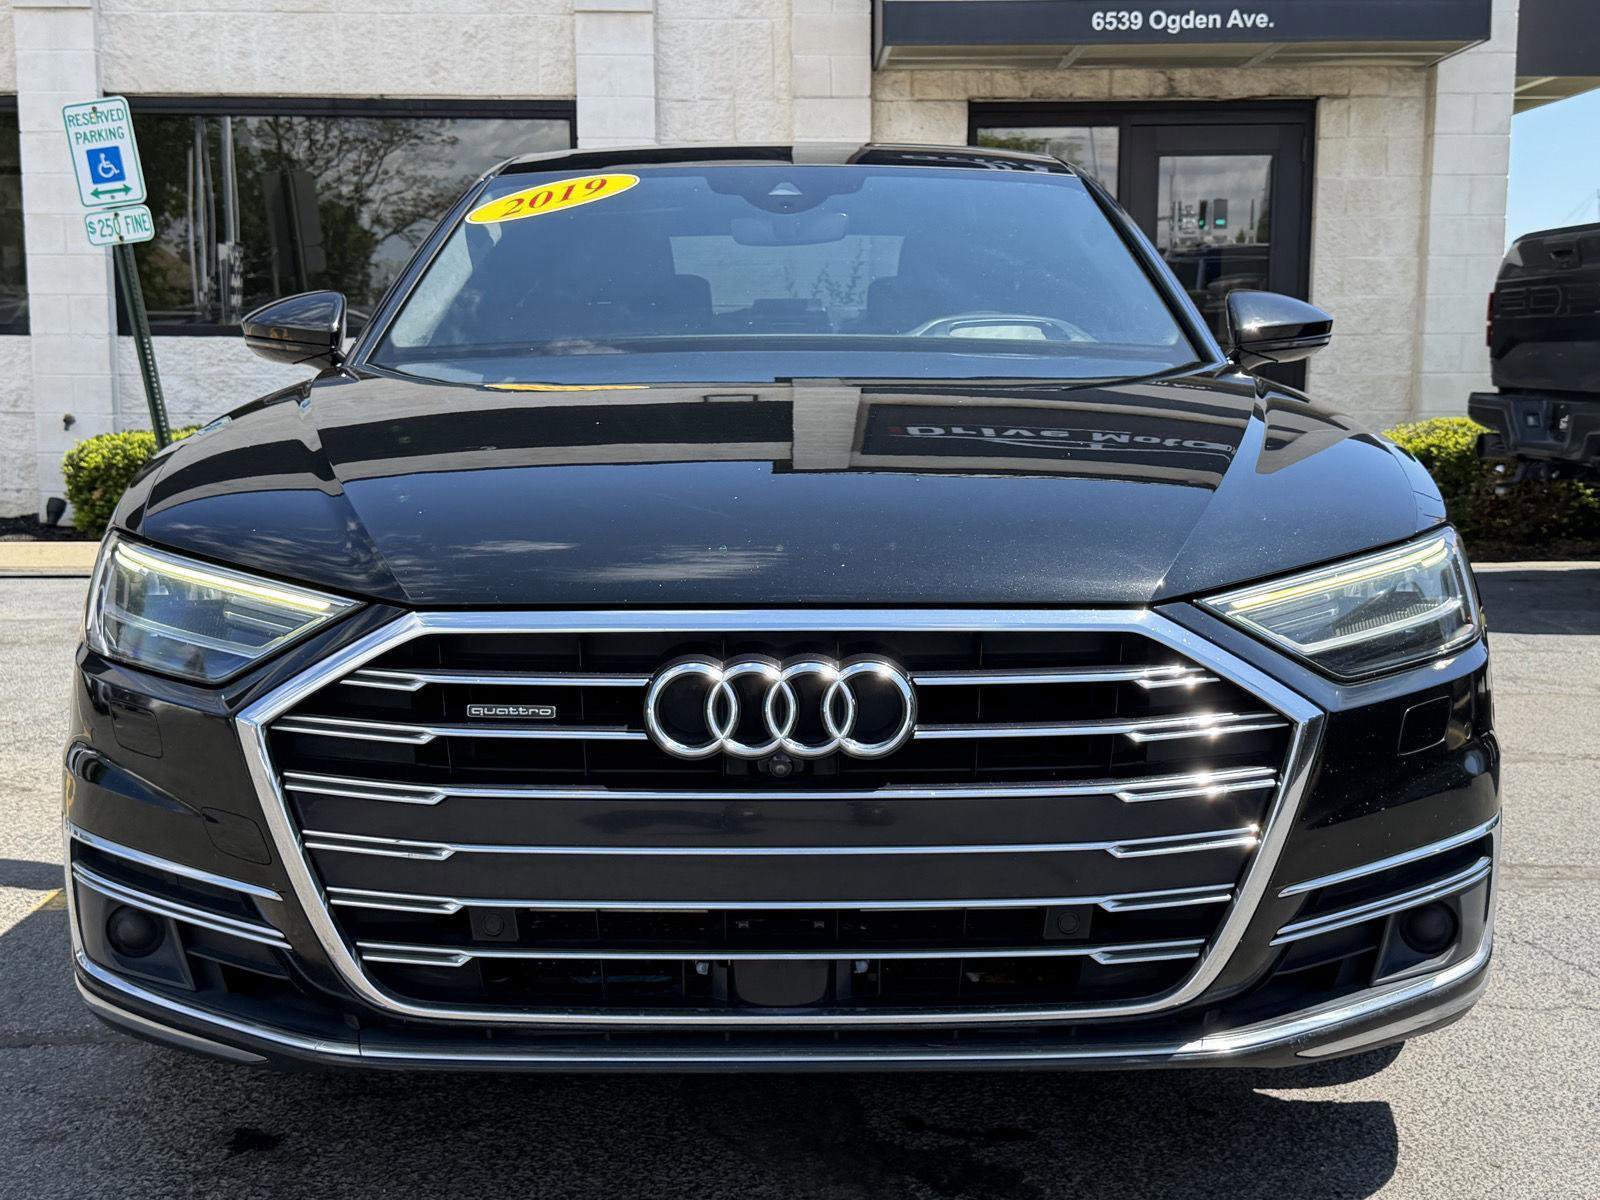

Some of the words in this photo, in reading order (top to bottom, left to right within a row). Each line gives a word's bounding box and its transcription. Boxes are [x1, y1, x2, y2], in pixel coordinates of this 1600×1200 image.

[1091, 11, 1143, 31] 6539
[1149, 10, 1221, 34] Ogden
[1226, 8, 1275, 29] Ave.
[67, 108, 125, 128] RESERVED
[75, 126, 125, 145] PARKING
[500, 178, 608, 218] 2019
[125, 212, 150, 234] FINE
[471, 706, 552, 716] quattro
